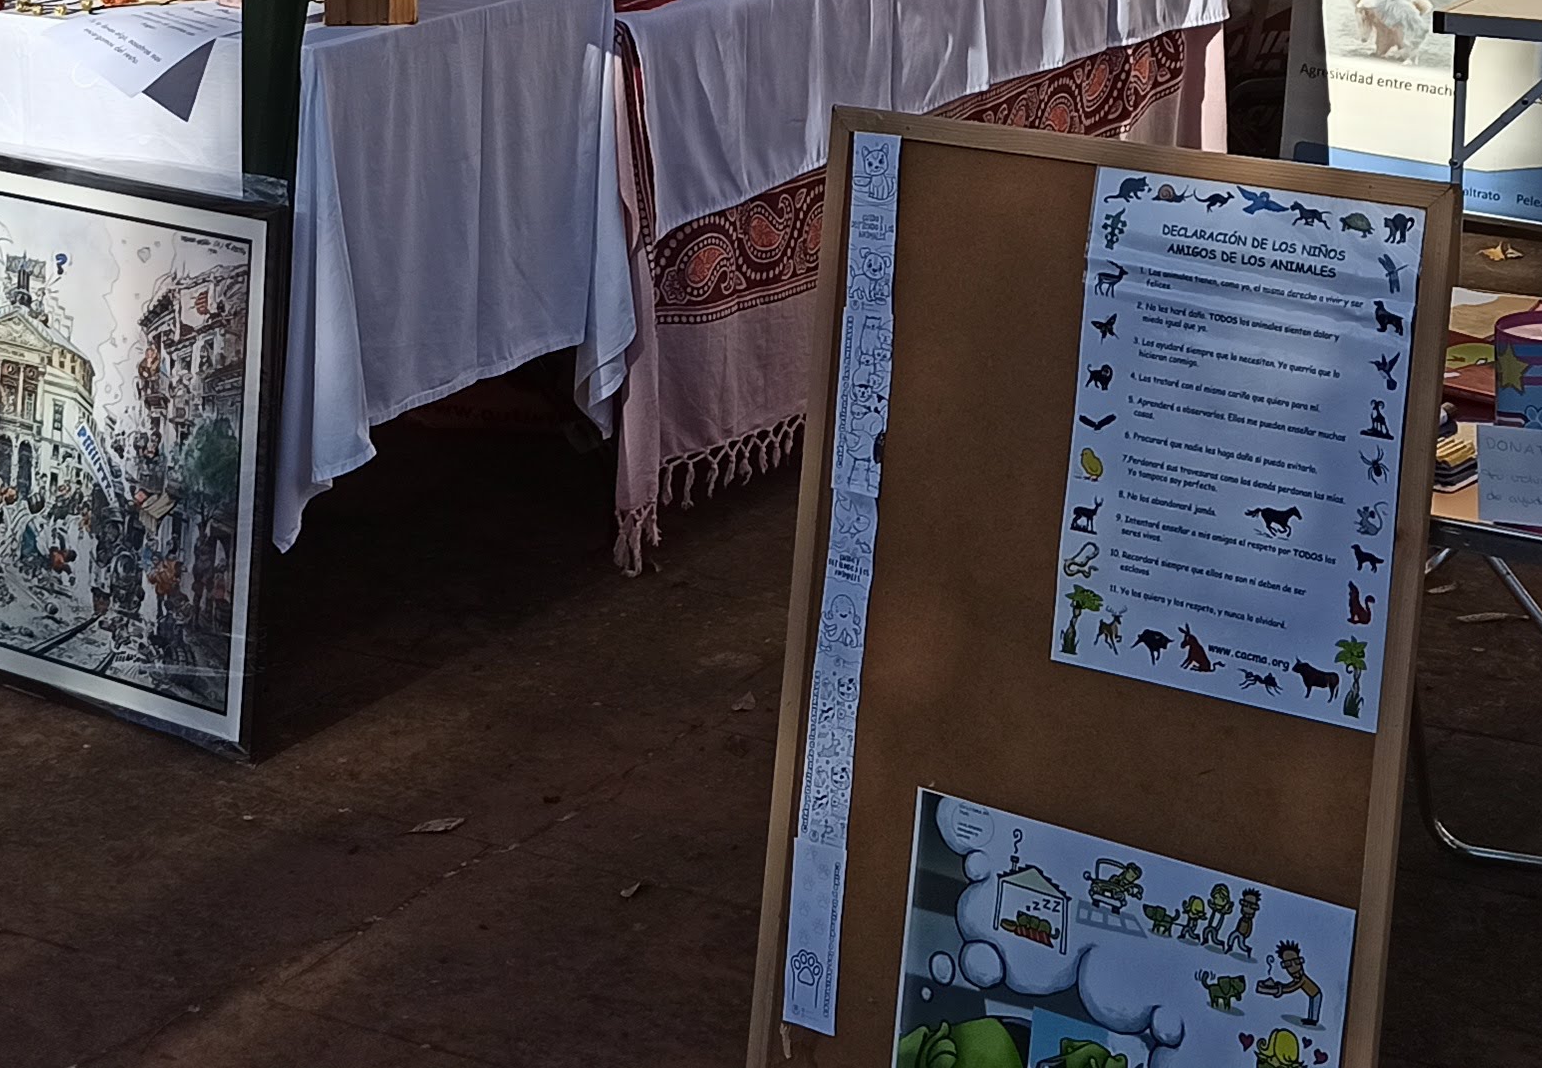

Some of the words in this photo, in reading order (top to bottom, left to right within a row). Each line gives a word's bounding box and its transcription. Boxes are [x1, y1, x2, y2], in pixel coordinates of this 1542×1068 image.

[1375, 76, 1413, 92] entre
[1161, 222, 1248, 247] DECLARACIÓN
[1250, 235, 1269, 251] DE
[1270, 238, 1297, 255] LOS
[1299, 242, 1346, 262] NIÑOS
[1165, 242, 1217, 261] AMIGOS
[1219, 249, 1238, 265] DE
[1239, 252, 1266, 268] LOS
[1268, 258, 1337, 279] ANIMALES
[1206, 643, 1290, 673] www.cacma.org
